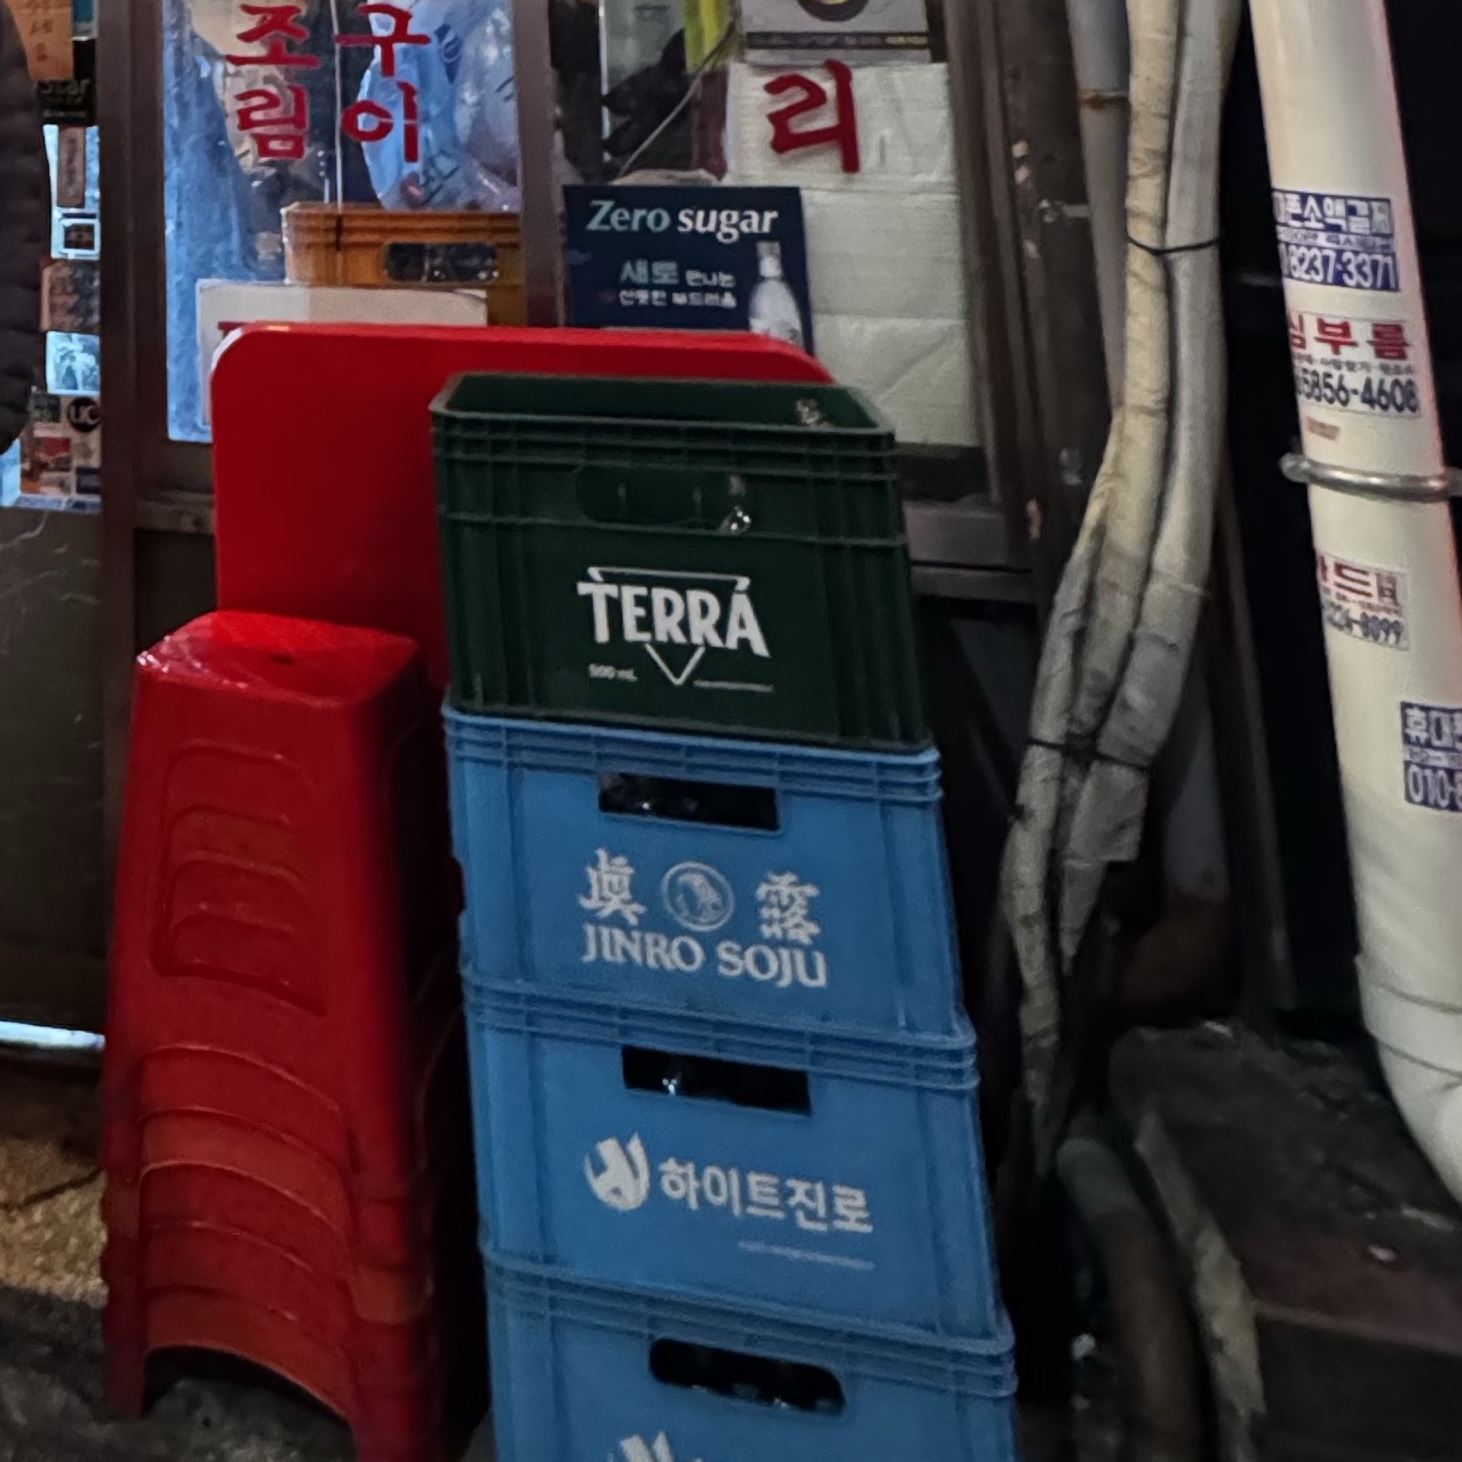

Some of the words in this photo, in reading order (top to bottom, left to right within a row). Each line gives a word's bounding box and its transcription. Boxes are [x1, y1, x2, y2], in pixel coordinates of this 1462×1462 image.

[585, 199, 671, 233] Zero
[676, 208, 779, 244] sugar
[619, 259, 679, 285] 새로
[577, 580, 772, 659] TERRA
[582, 920, 706, 972] JINRO
[715, 939, 827, 989] SOJU
[658, 1156, 874, 1233] 하이트진로
